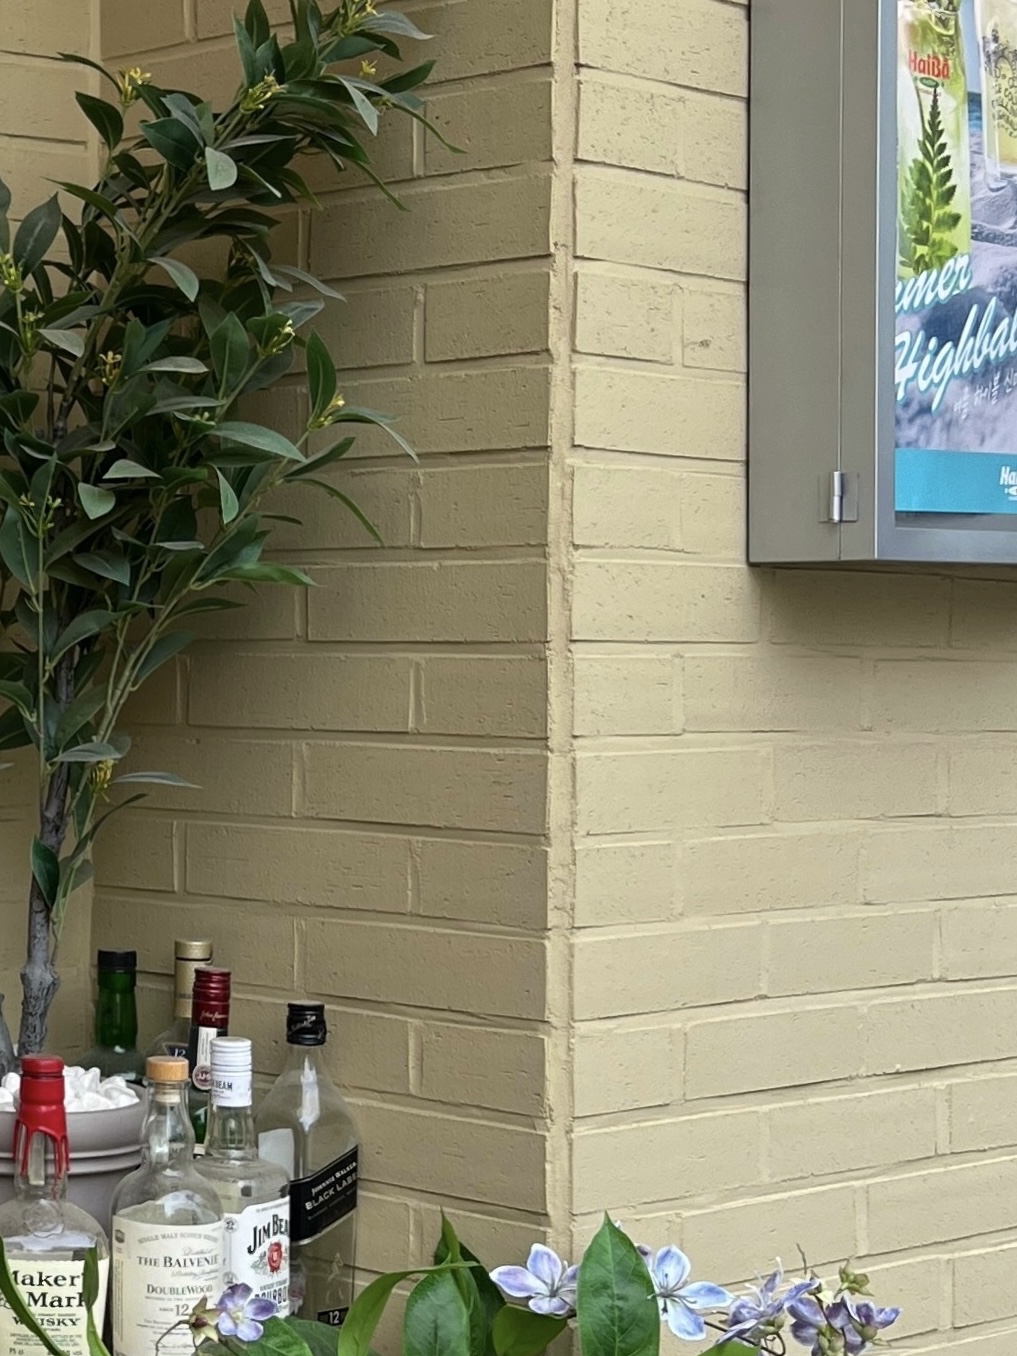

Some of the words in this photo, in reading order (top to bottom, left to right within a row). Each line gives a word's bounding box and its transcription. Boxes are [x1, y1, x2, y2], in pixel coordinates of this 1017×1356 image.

[895, 254, 974, 313] mer
[305, 1186, 335, 1211] BLACK
[247, 1221, 271, 1255] JIM
[137, 1256, 160, 1267] THE
[174, 1304, 190, 1317] 12
[329, 1310, 340, 1325] 12
[12, 1316, 81, 1327] WISKY
